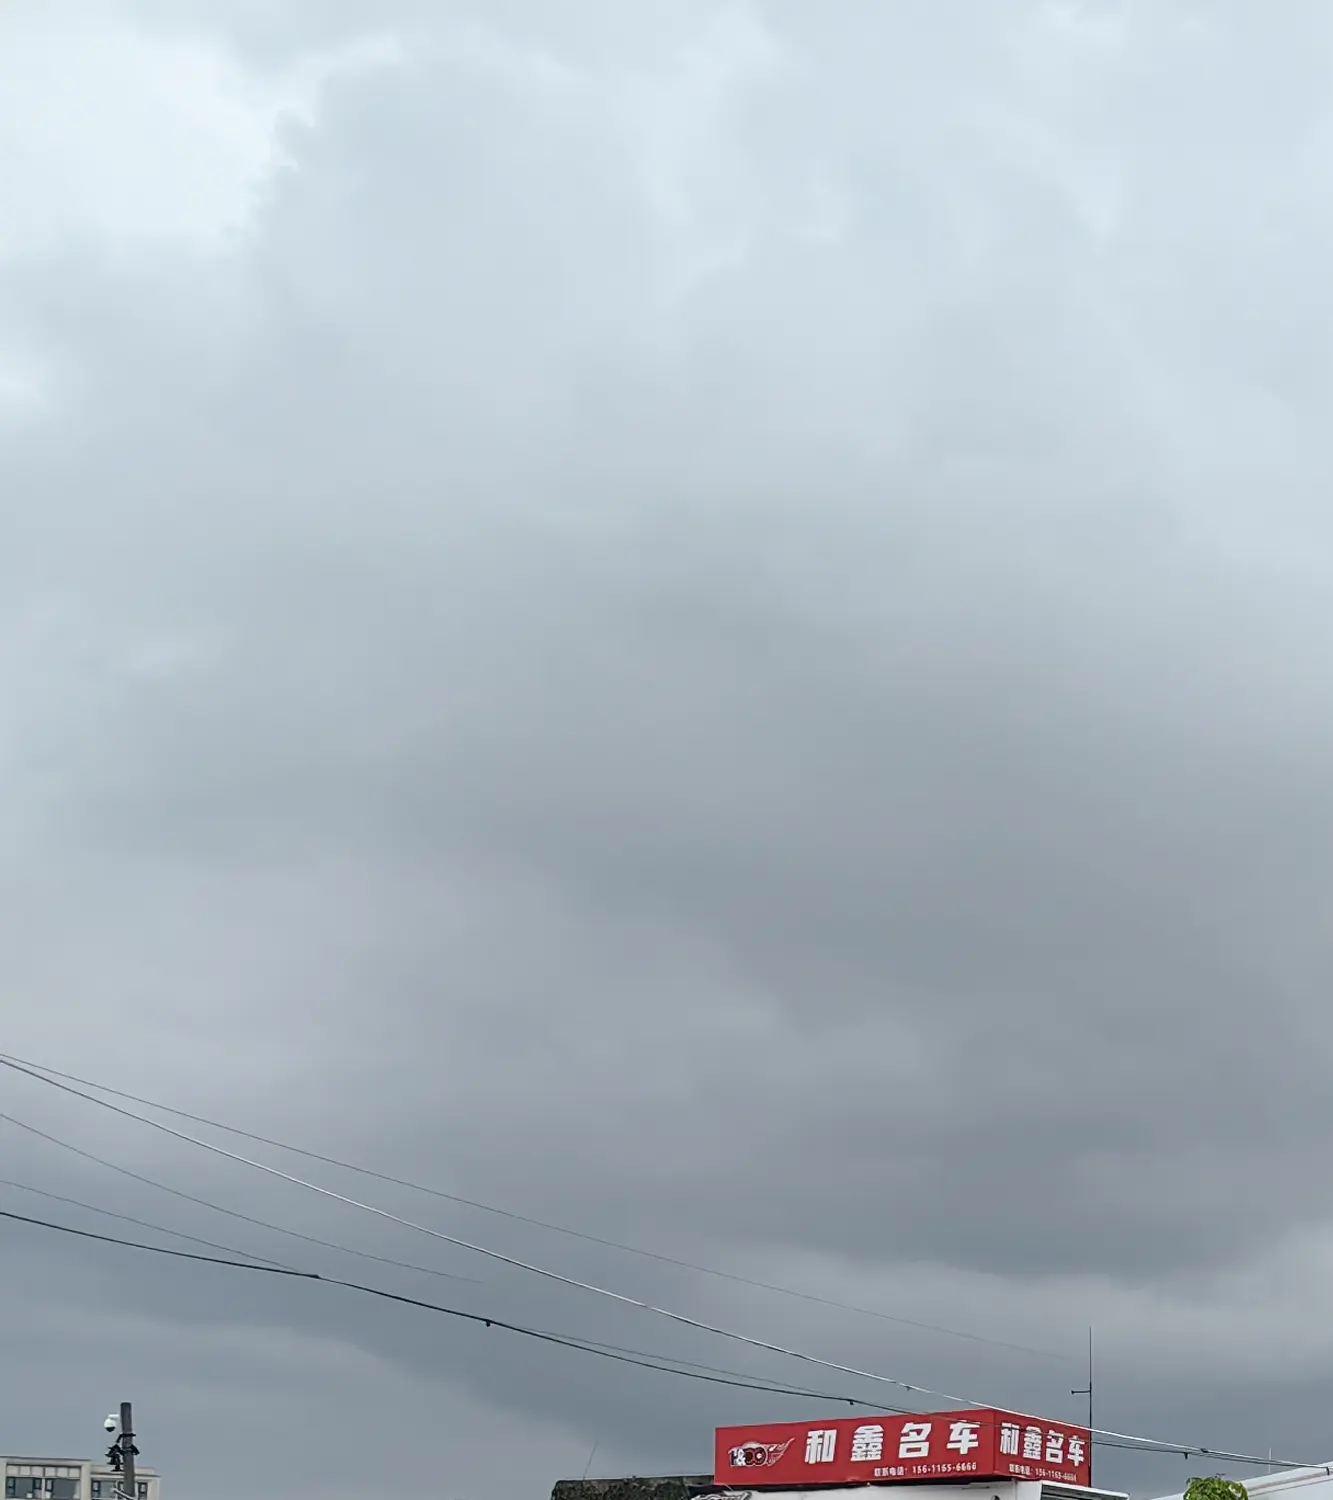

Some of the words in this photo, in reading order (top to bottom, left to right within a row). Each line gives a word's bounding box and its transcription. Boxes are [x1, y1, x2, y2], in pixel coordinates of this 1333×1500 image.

[804, 1420, 980, 1464] 和鑫名车
[1000, 1422, 1085, 1467] 和鑫名车
